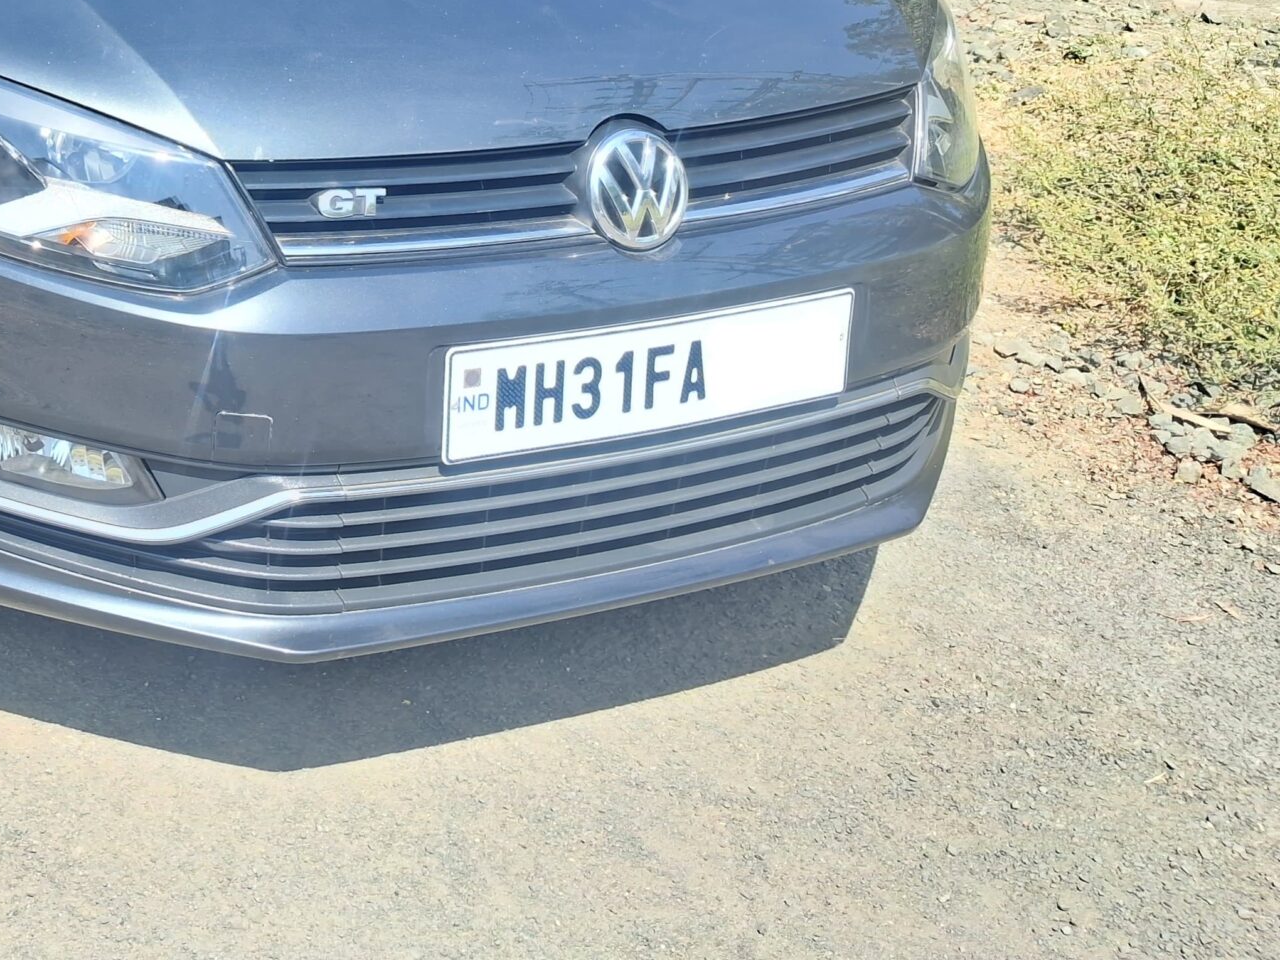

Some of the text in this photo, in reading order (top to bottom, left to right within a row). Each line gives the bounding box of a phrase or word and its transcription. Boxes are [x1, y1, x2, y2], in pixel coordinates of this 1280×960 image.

[318, 187, 387, 219] GT
[591, 131, 685, 245] VW
[457, 393, 490, 414] IND
[494, 340, 707, 432] MH31FA
